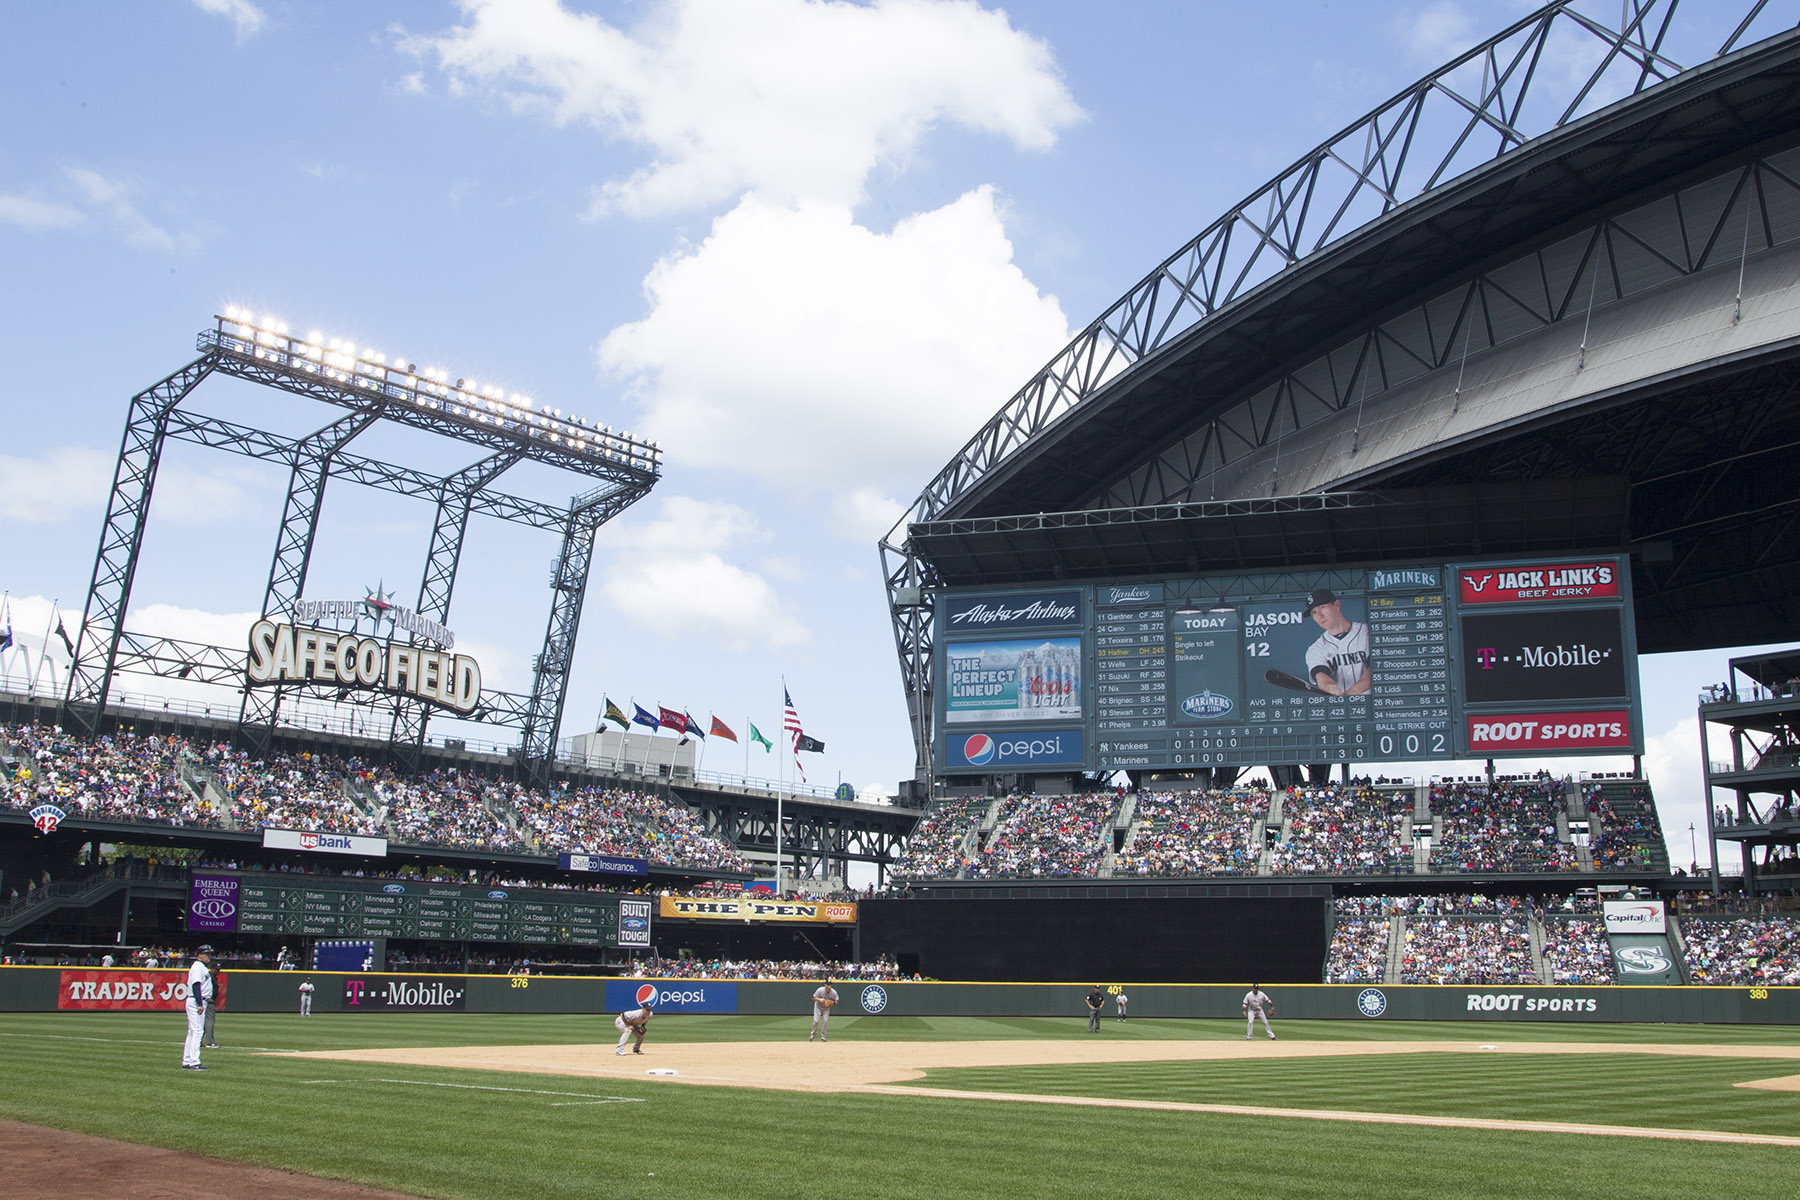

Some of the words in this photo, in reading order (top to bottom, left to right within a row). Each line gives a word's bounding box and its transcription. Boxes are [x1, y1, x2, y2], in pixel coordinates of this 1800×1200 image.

[1374, 571, 1436, 590] MARINERS
[1498, 570, 1545, 590] JACK
[1548, 566, 1613, 587] LINK'S
[1109, 586, 1151, 604] Yankees
[1518, 589, 1549, 598] BEEF
[1552, 587, 1592, 597] JERKY
[951, 603, 1012, 624] Alaska
[1011, 600, 1076, 620] Airlines
[1245, 612, 1302, 626] JASON
[294, 598, 360, 622] SEATTLE
[394, 604, 455, 649] MARINERS
[1184, 618, 1226, 628] TODAY
[1245, 627, 1269, 638] BAY
[1247, 642, 1270, 657] 12
[250, 620, 382, 686] SAFECO
[386, 643, 481, 713] FIELD
[952, 659, 980, 671] THE
[952, 670, 1015, 684] PERFECT
[952, 684, 1003, 697] LINEUP
[1029, 675, 1072, 695] Coors
[1033, 694, 1070, 708] LIGHT
[1186, 696, 1230, 710] MARINERS
[1473, 722, 1538, 742] ROOT
[1540, 722, 1622, 739] SPORTS
[998, 736, 1060, 759] pepsi
[1174, 740, 1181, 749] 0
[1190, 740, 1194, 748] 1
[1202, 739, 1209, 748] 0
[1216, 738, 1223, 747] 0
[1230, 738, 1237, 747] 0
[1322, 736, 1326, 744] 1
[1338, 735, 1345, 743] 5
[1355, 734, 1363, 743] 0
[1380, 736, 1393, 754] 0
[1406, 735, 1419, 753] 0
[1432, 734, 1445, 752] 2
[1114, 756, 1149, 764] Mariners
[1175, 754, 1182, 763] 0
[1190, 754, 1195, 762] 1
[1203, 754, 1209, 762] 0
[1217, 753, 1223, 762] 0
[1322, 750, 1327, 758] 1
[1339, 749, 1346, 758] 3
[1356, 748, 1363, 758] 0
[36, 816, 57, 831] 42
[572, 857, 598, 869] Safeco
[600, 860, 634, 872] Insurance
[194, 880, 238, 890] EMERALD
[429, 888, 460, 896] Scoreboard
[200, 888, 230, 898] QUEEN
[198, 901, 235, 919] EQC
[622, 904, 648, 917] BUILT
[674, 902, 739, 914] THE
[826, 907, 852, 916] ROOT
[627, 920, 642, 928] Ford
[620, 930, 648, 942] TOUGH
[511, 978, 528, 988] 376
[70, 982, 154, 1000] TRADER
[160, 982, 188, 1000] JO
[660, 988, 704, 1005] pepsi
[1107, 986, 1122, 995] 401
[1750, 990, 1768, 999] 380
[1466, 994, 1524, 1011] ROOT
[1526, 998, 1597, 1012] SPORTS
